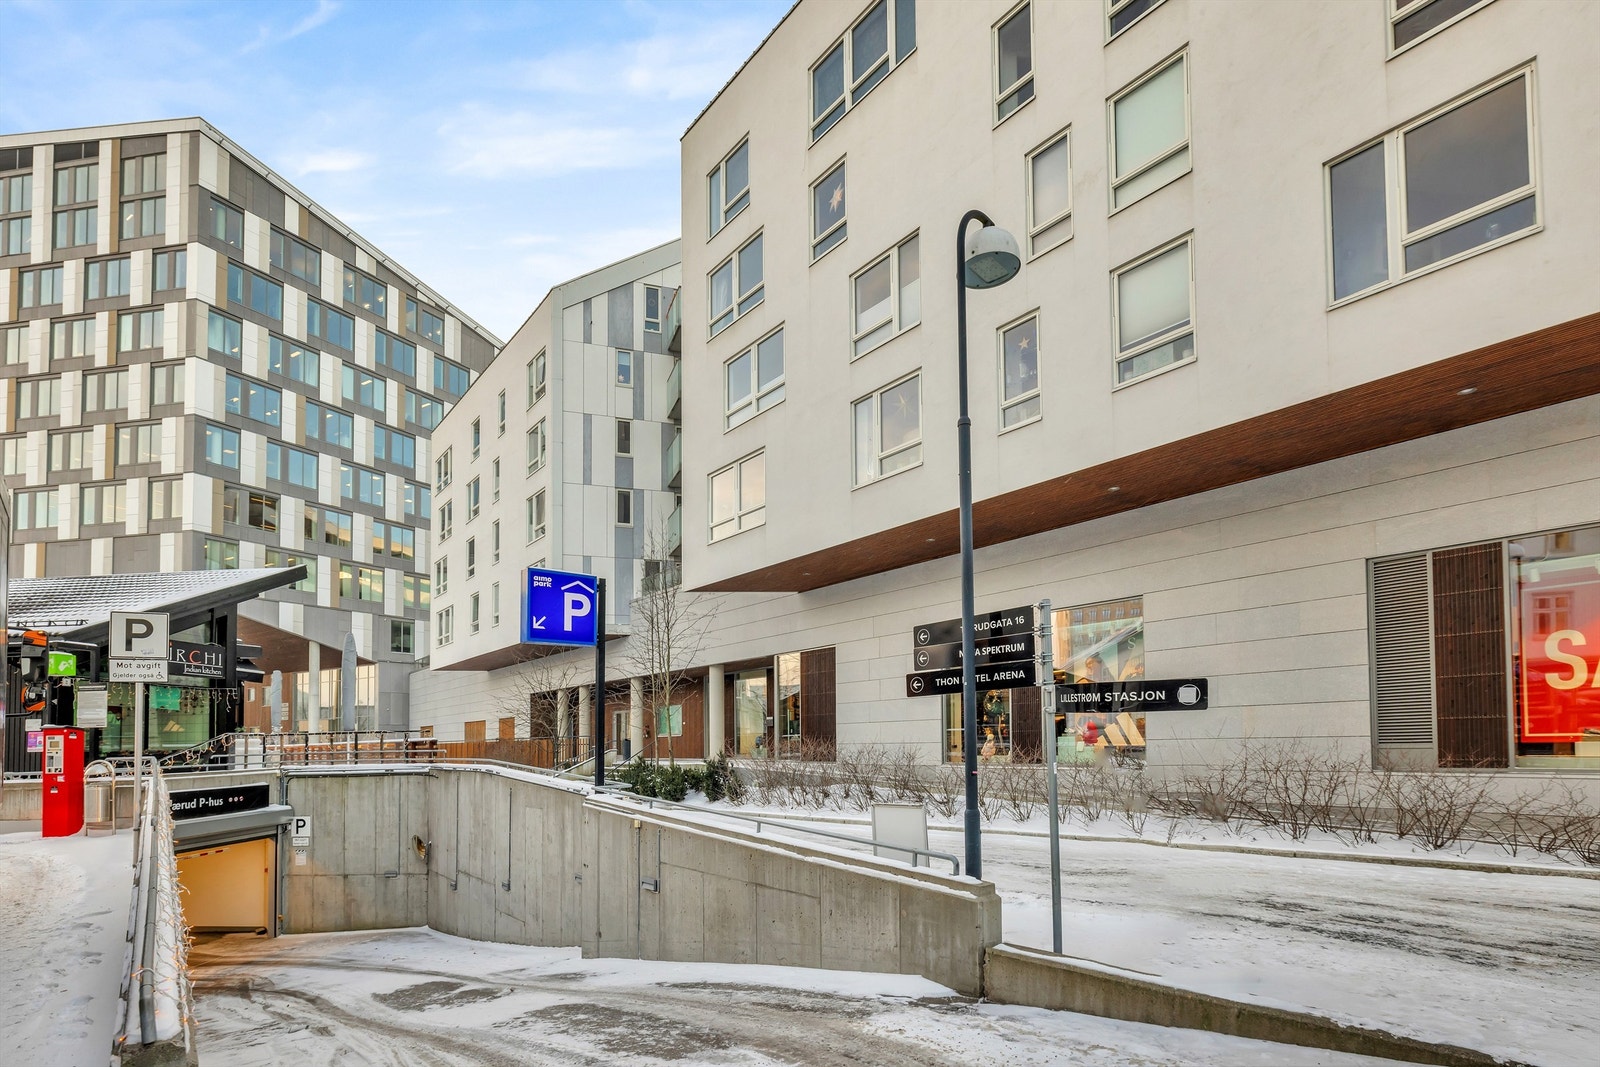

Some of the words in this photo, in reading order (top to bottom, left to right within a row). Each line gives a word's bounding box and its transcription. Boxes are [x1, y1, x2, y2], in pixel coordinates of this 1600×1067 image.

[563, 592, 591, 632] P
[960, 617, 1013, 633] RUDGATA
[1014, 615, 1025, 625] 16
[125, 618, 154, 652] P
[958, 648, 981, 658] NA
[982, 642, 1025, 656] SPEKTRUM
[136, 662, 161, 670] avgift
[1544, 629, 1600, 690] S
[935, 676, 960, 687] THON
[962, 674, 991, 685] TEL
[993, 670, 1026, 681] ARENA
[1060, 691, 1101, 703] LILLESTRØM
[1104, 690, 1166, 702] STASJON
[171, 798, 197, 811] ærud
[199, 796, 223, 808] P-hus
[295, 818, 306, 834] P
